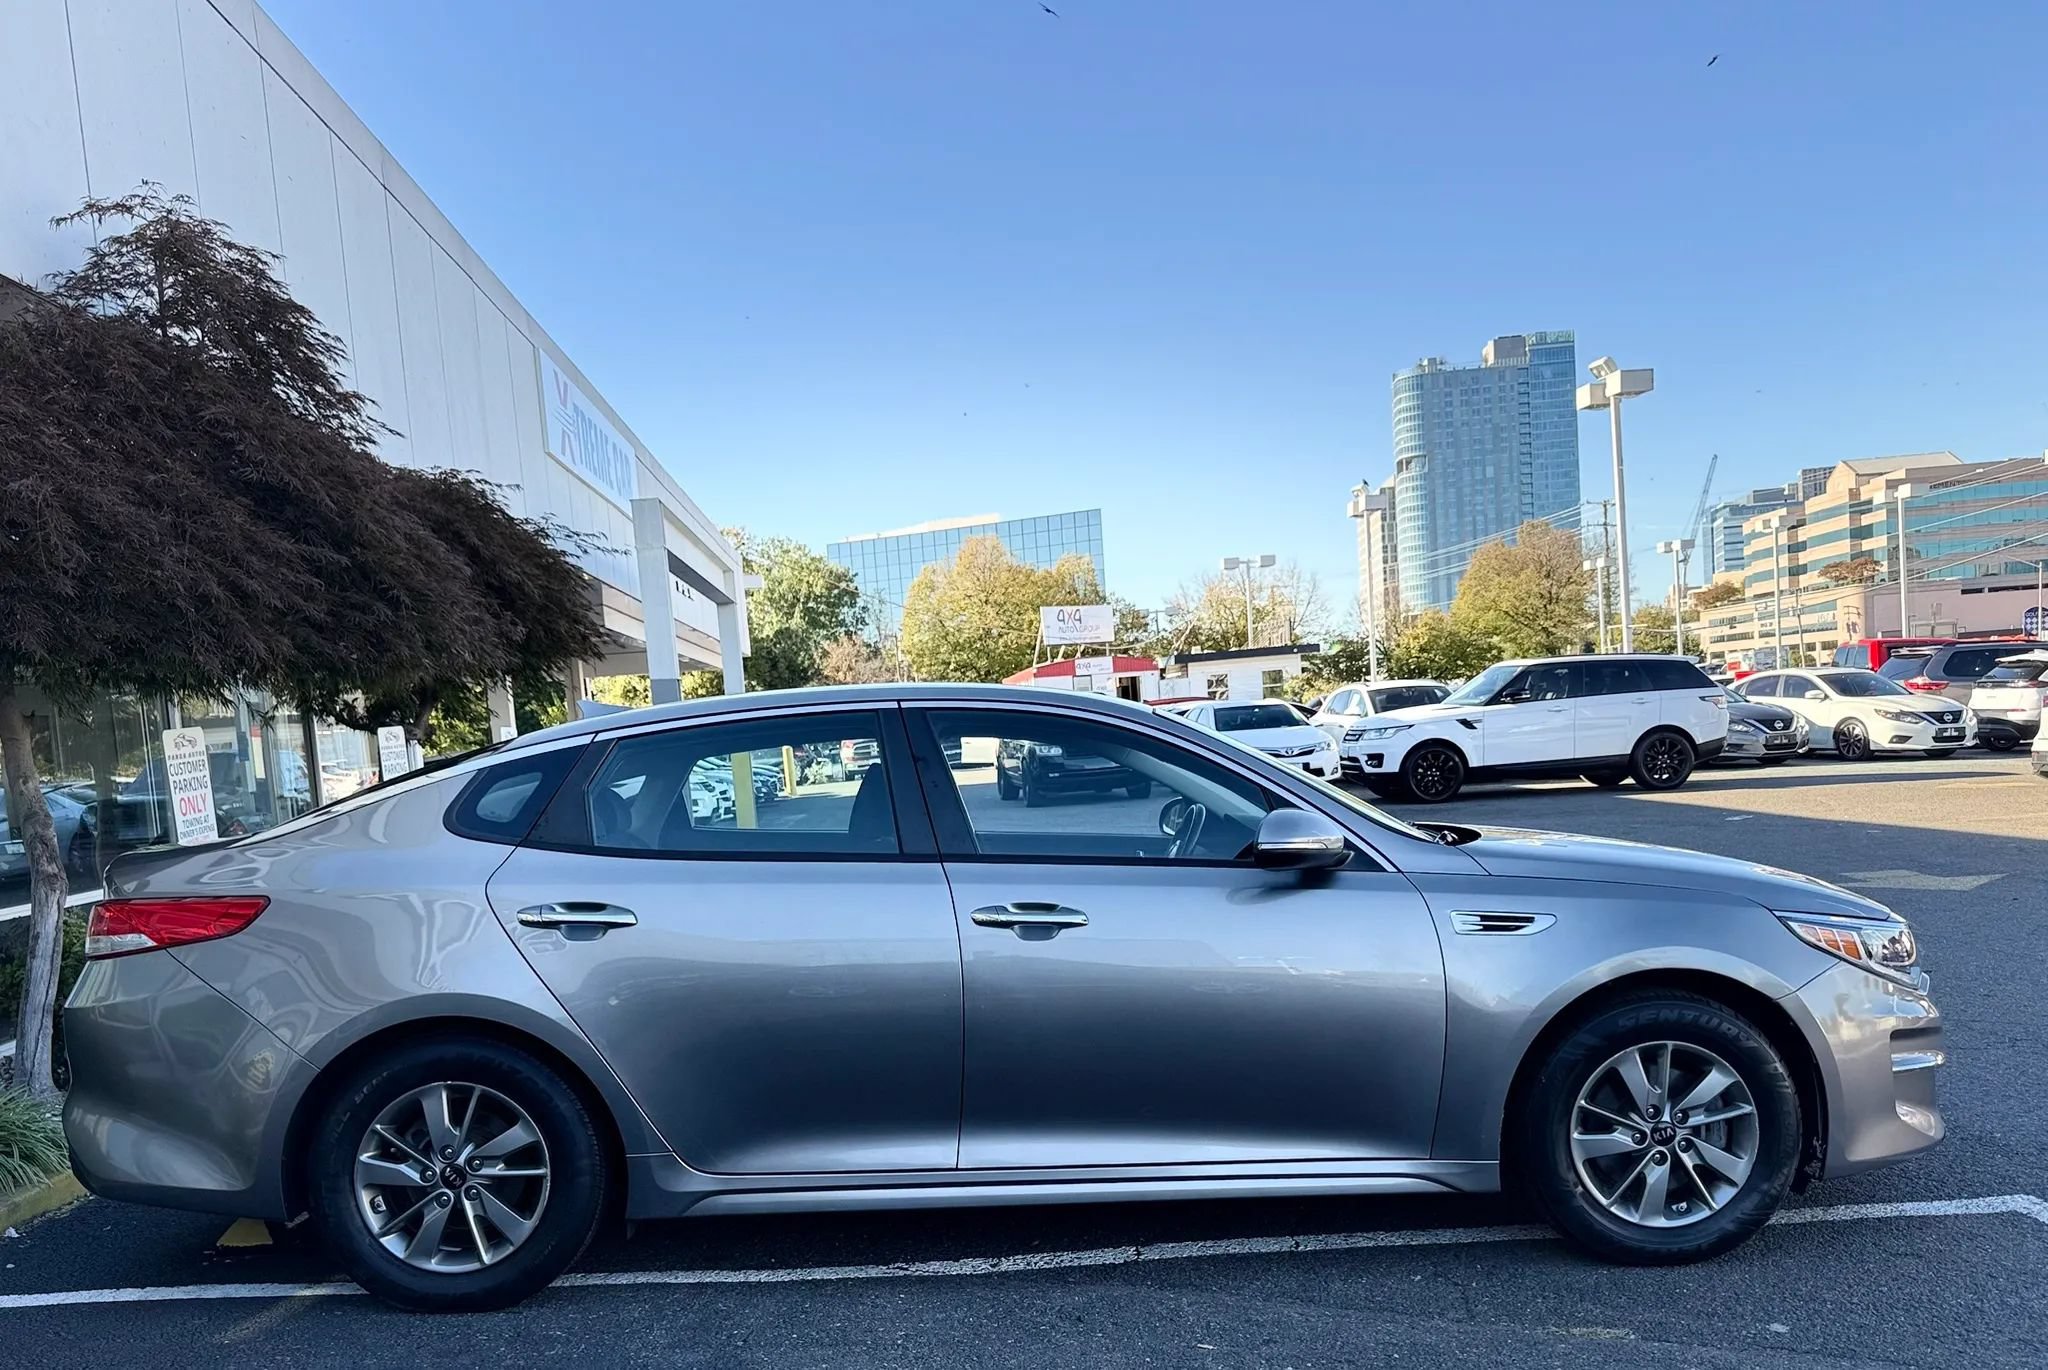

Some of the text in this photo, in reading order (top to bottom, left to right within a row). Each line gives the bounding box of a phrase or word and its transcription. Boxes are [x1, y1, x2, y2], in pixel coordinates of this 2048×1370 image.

[168, 759, 207, 777] CUSTOMER
[172, 775, 209, 794] PARKING
[179, 793, 208, 816] ONLY
[1653, 1128, 1675, 1141] KIA
[445, 1167, 463, 1187] KIA
